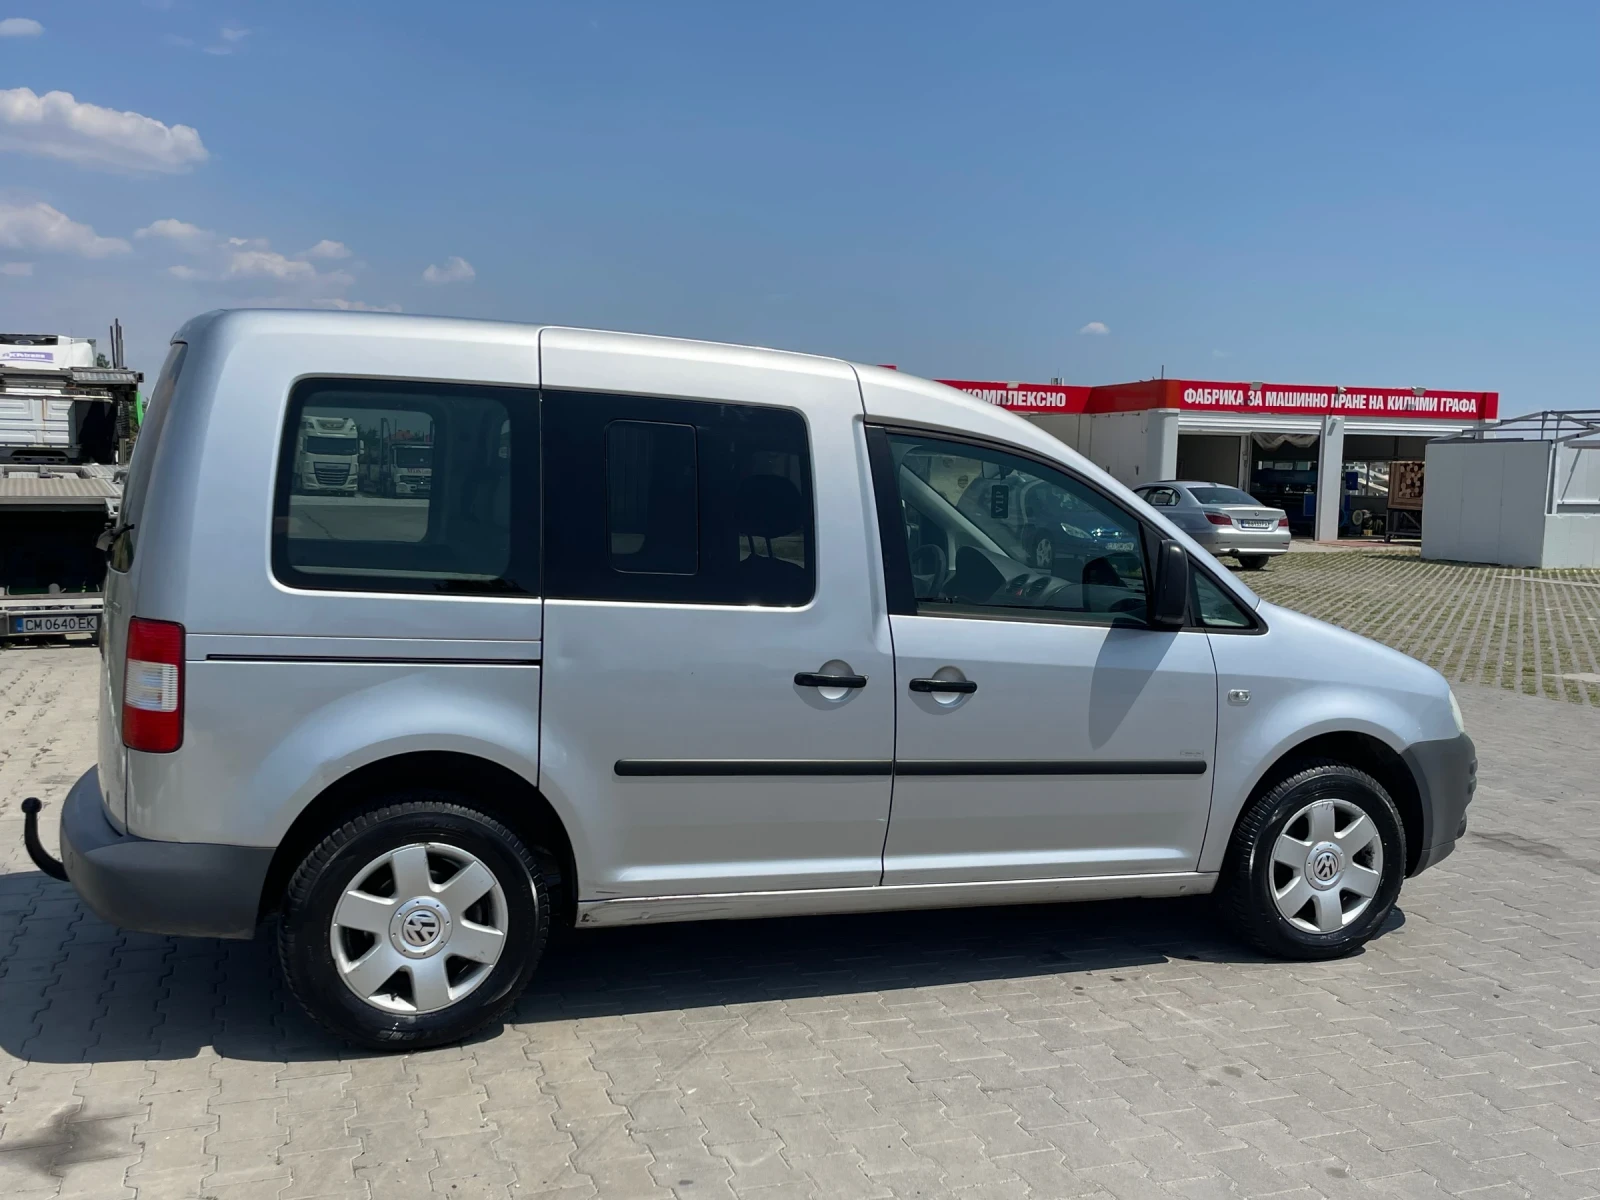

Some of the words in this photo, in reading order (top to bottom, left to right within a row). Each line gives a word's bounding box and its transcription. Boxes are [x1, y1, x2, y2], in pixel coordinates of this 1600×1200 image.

[1183, 388, 1244, 406] ФАБРИКА
[1247, 390, 1262, 407] ЗА
[1265, 391, 1328, 408] МАШИННО
[1331, 393, 1366, 409] ПРАНЕ
[1369, 395, 1383, 410] НА
[1387, 395, 1437, 412] КИЛИМИ
[1440, 397, 1476, 413] ГРАФА
[995, 490, 1004, 513] VIP
[25, 619, 42, 631] CM
[45, 618, 76, 630] 0640
[78, 617, 95, 629] EK
